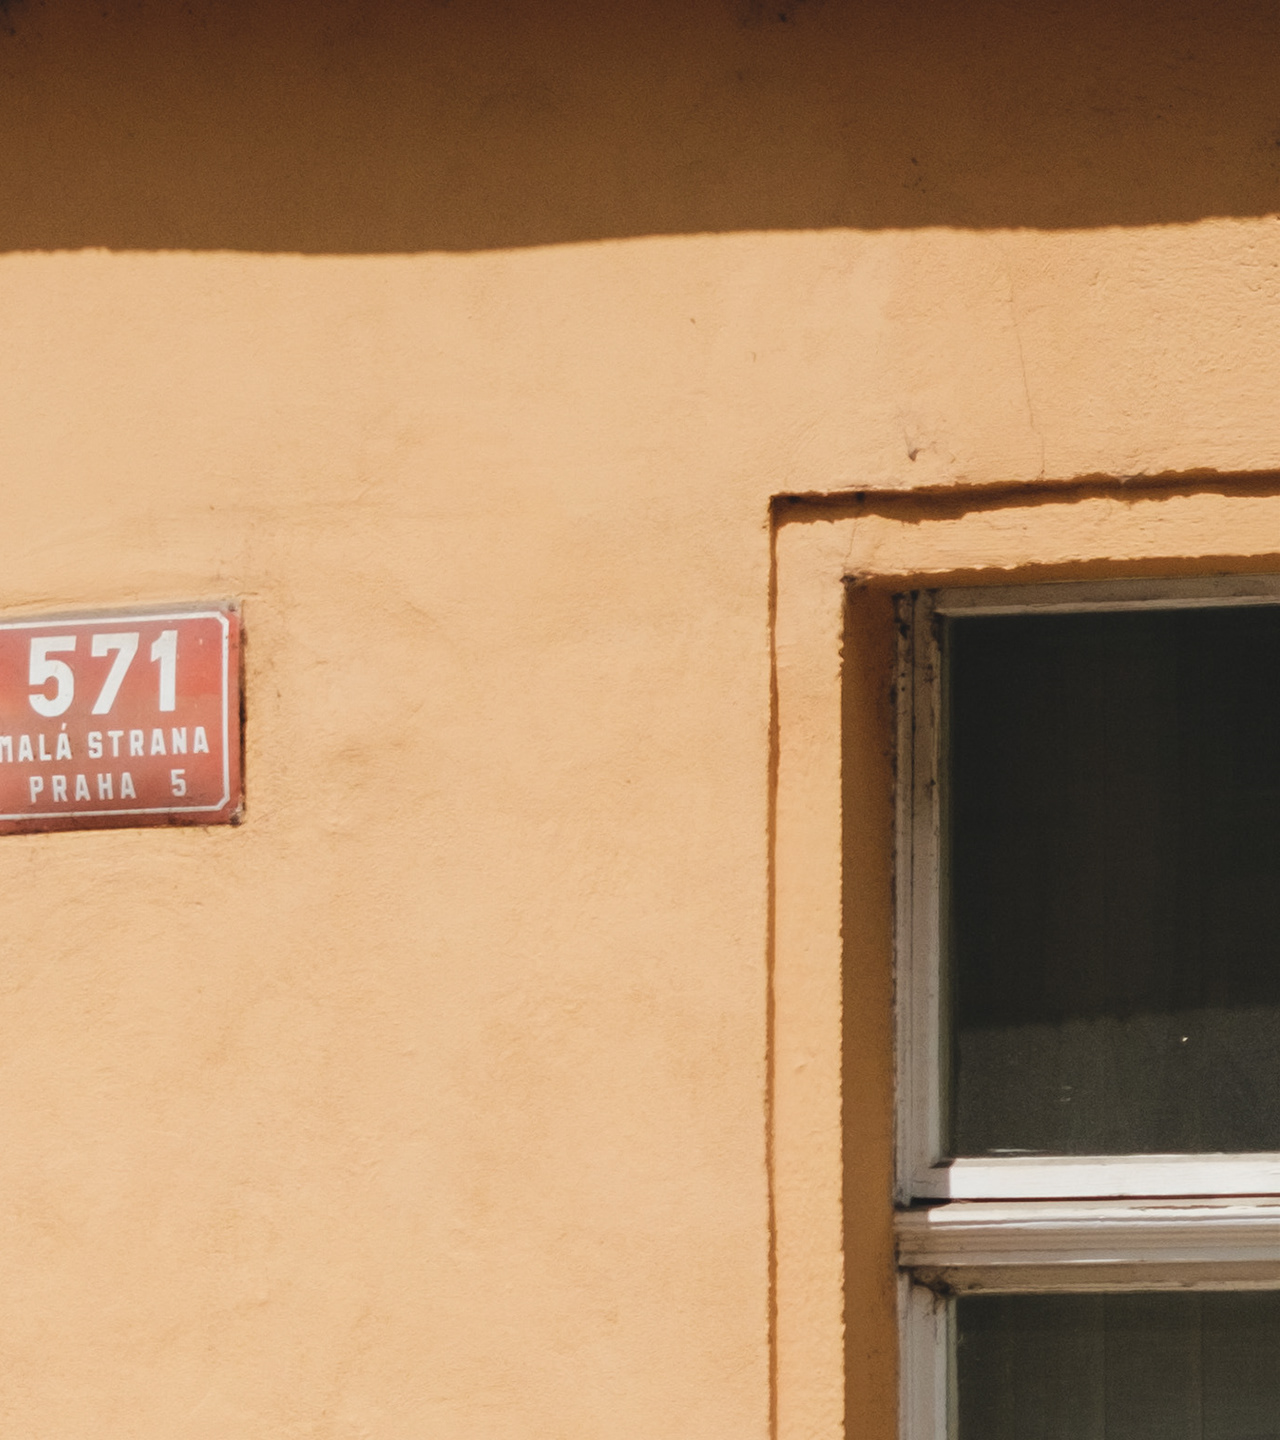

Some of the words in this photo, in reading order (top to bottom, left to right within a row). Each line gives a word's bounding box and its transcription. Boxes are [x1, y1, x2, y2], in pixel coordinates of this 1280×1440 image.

[28, 630, 178, 717] 571
[88, 726, 210, 758] STRANA
[29, 772, 137, 803] PRAHA
[170, 769, 186, 796] 5
